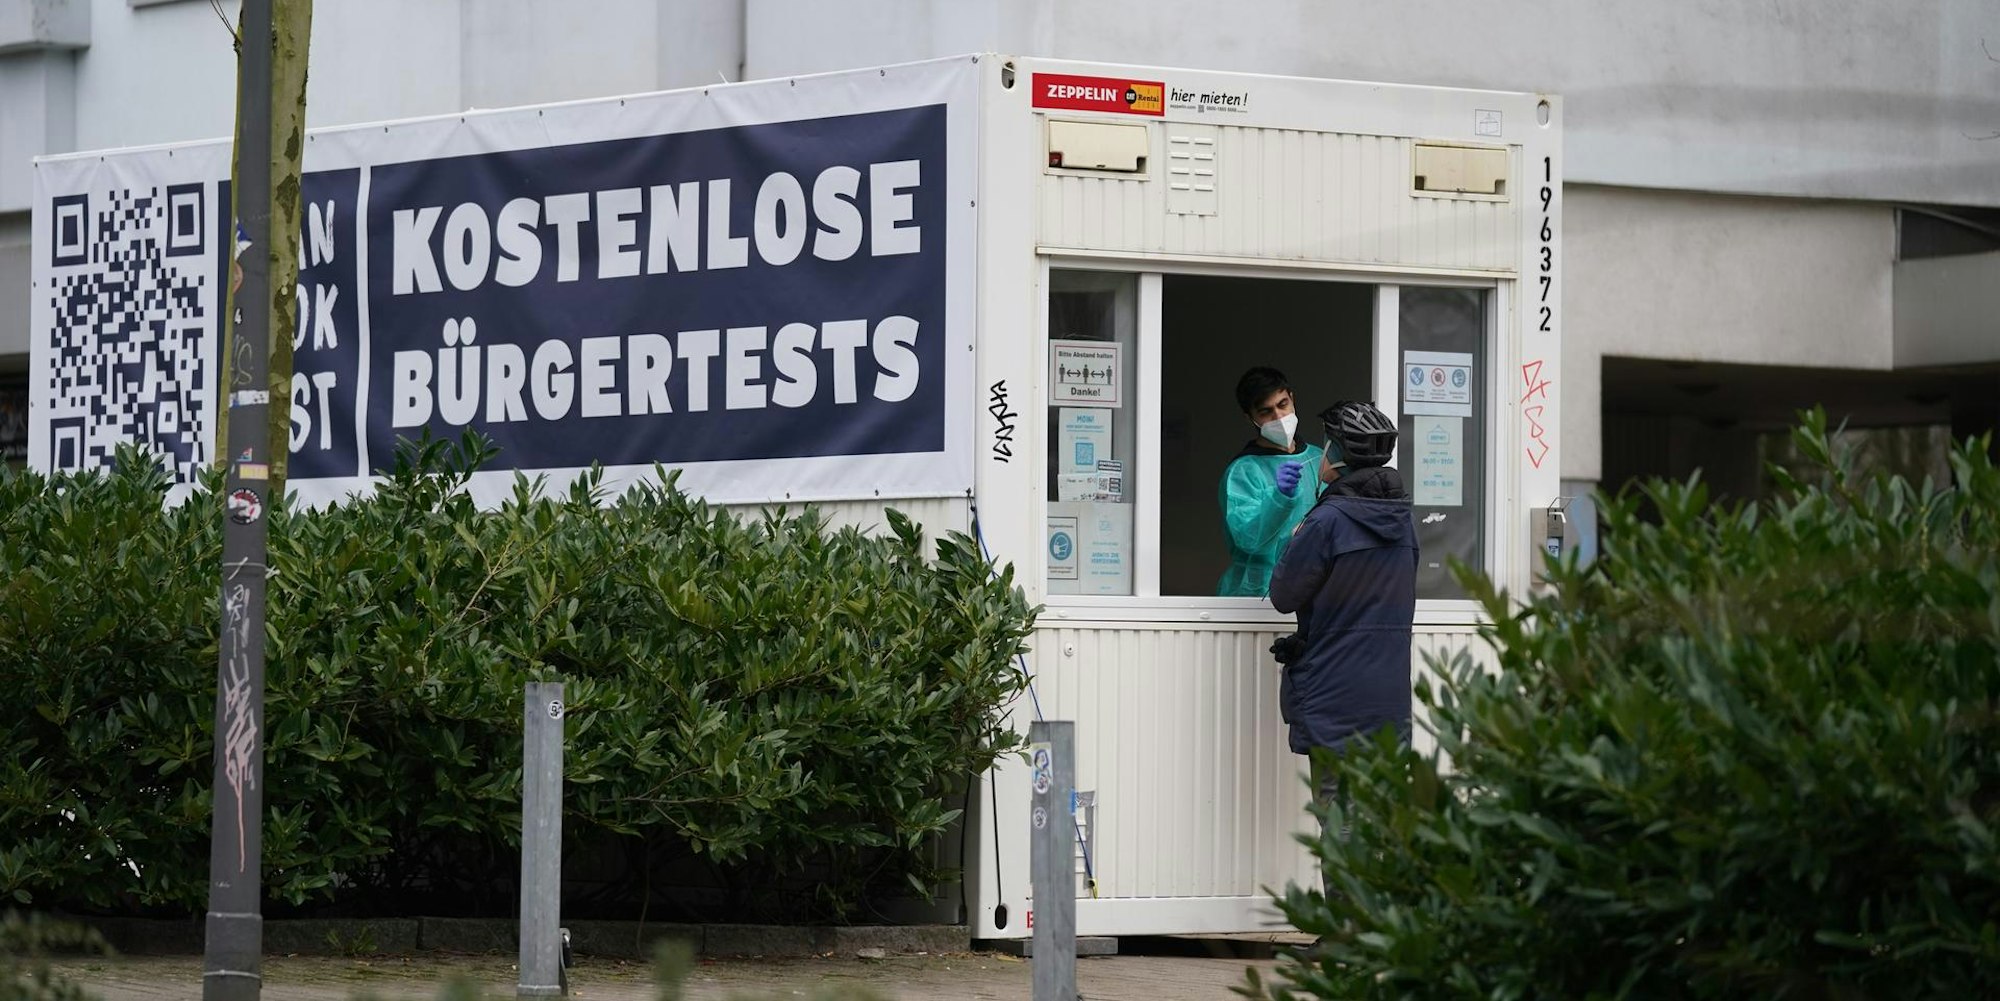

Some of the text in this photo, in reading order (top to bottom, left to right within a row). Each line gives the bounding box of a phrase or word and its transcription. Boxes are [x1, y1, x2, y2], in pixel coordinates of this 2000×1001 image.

[1047, 84, 1117, 102] ZEPPELIN
[1137, 93, 1160, 103] Rental
[1170, 87, 1196, 103] hier
[1200, 91, 1241, 106] mieten
[393, 159, 921, 295] KOSTENLOSE
[1539, 156, 1552, 332] 196372
[392, 315, 921, 428] BÜRGERTESTS
[1070, 387, 1101, 397] Danke!
